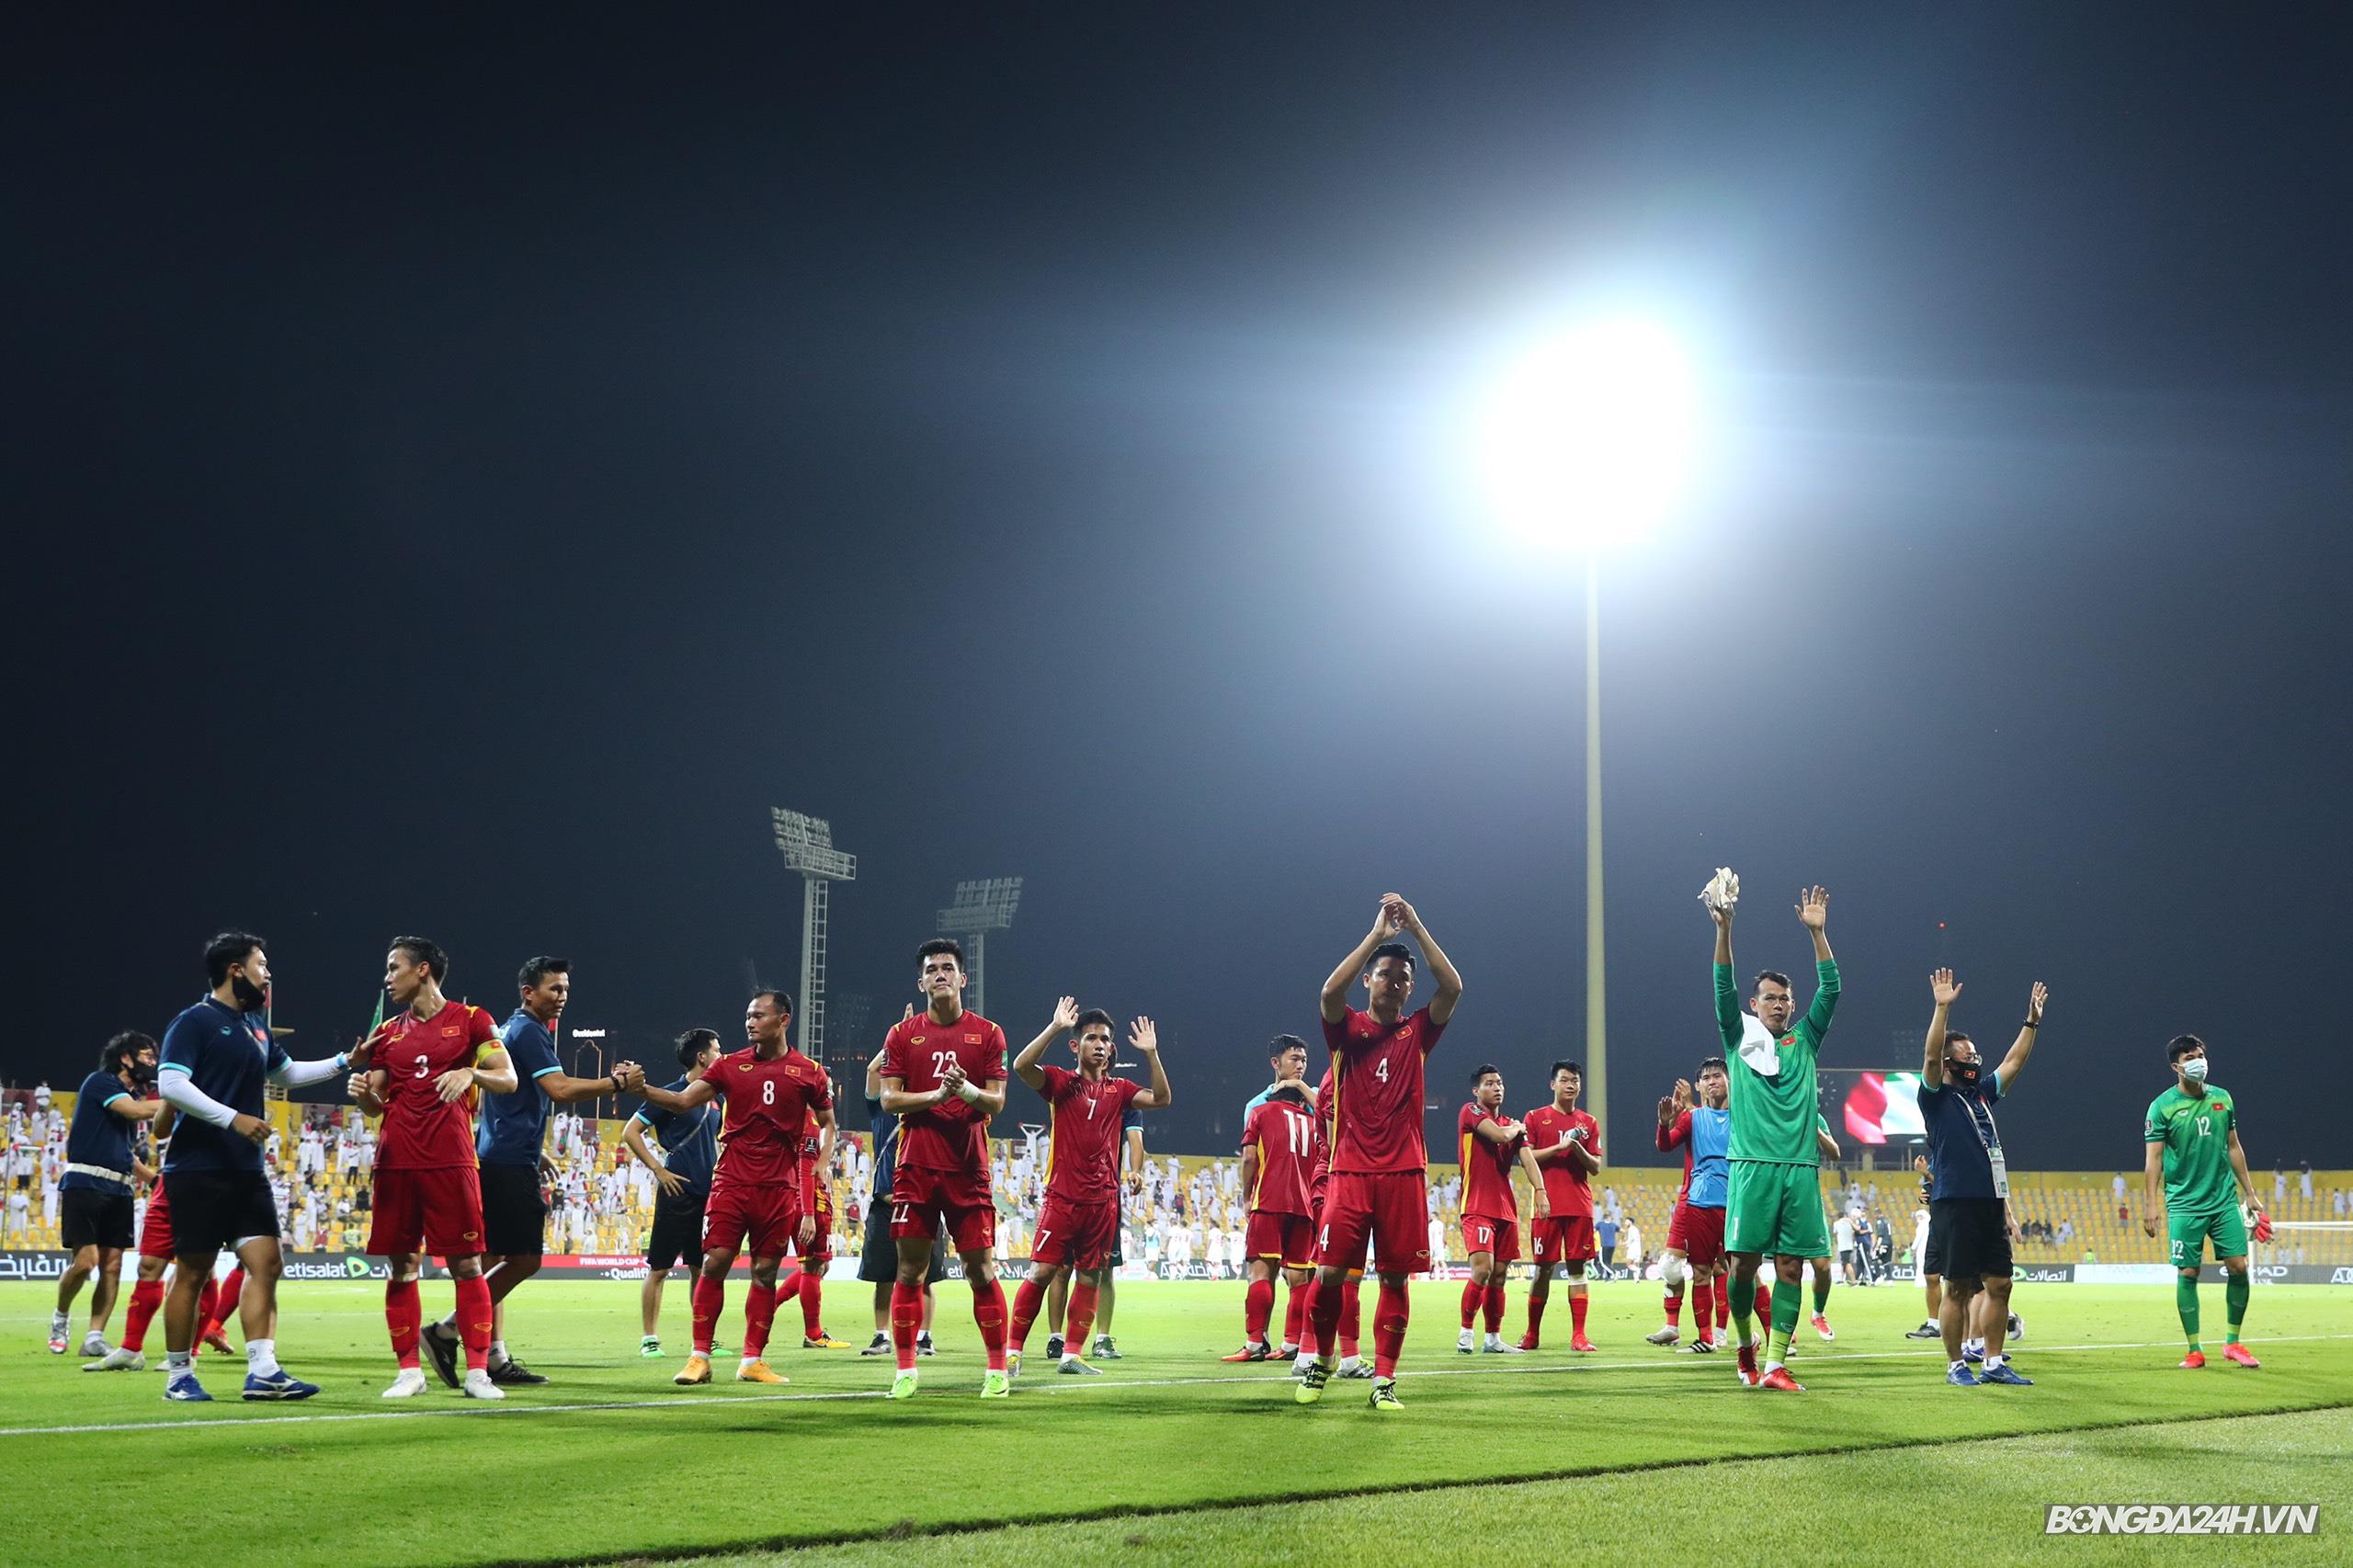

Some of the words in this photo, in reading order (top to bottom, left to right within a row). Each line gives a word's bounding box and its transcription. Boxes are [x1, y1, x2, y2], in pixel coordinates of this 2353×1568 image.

[415, 1054, 429, 1079] 3
[1375, 1057, 1389, 1083] 4
[763, 1080, 775, 1105] 8
[1087, 1097, 1097, 1120] 7
[1282, 1108, 1310, 1157] 11
[2195, 1116, 2211, 1137] 12
[1036, 1229, 1052, 1252] 7
[1319, 1223, 1330, 1252] 4
[1478, 1226, 1491, 1244] 17
[1733, 1217, 1739, 1241] 1
[1533, 1236, 1544, 1256] 16
[2171, 1239, 2185, 1260] 12
[283, 1262, 347, 1278] etisalat
[579, 1257, 597, 1266] FIFA
[597, 1257, 625, 1266] WORLD
[626, 1257, 640, 1266] CUP
